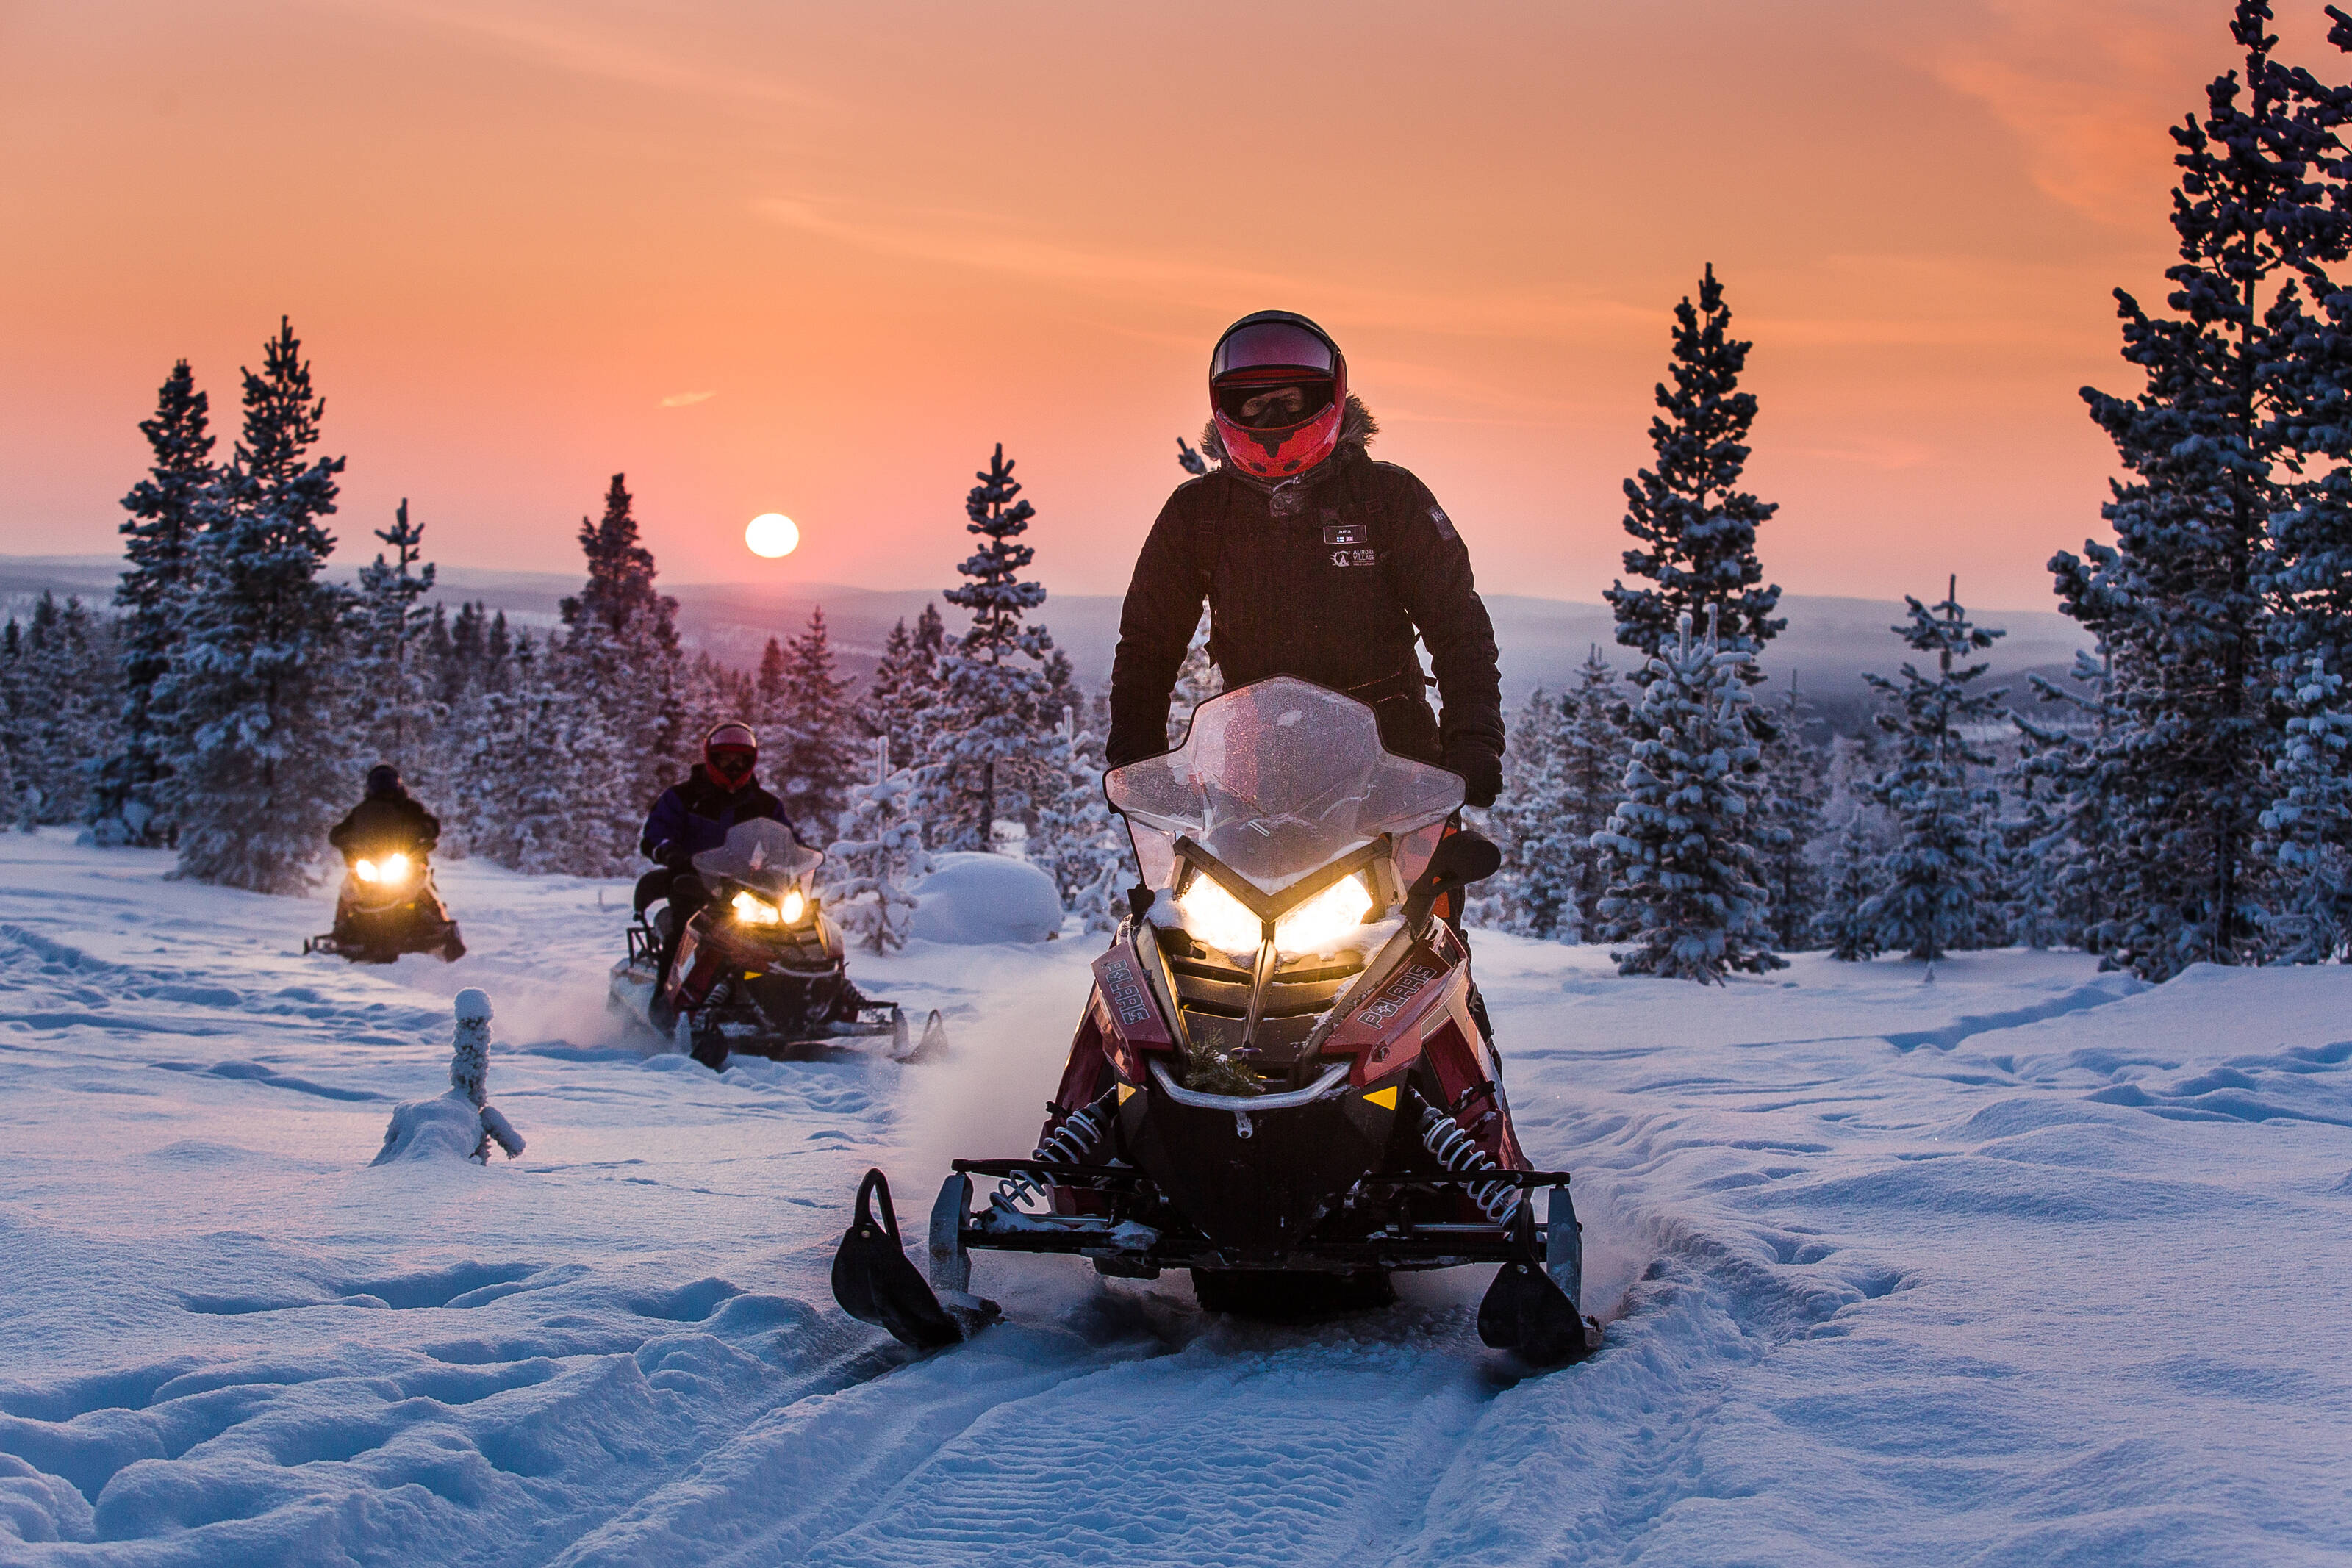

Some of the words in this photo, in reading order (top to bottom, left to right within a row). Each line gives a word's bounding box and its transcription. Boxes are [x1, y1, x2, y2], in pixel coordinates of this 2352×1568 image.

[1431, 509, 1446, 522] HH
[1101, 959, 1150, 1025] POLARIS
[1357, 965, 1438, 1030] POLARIS
